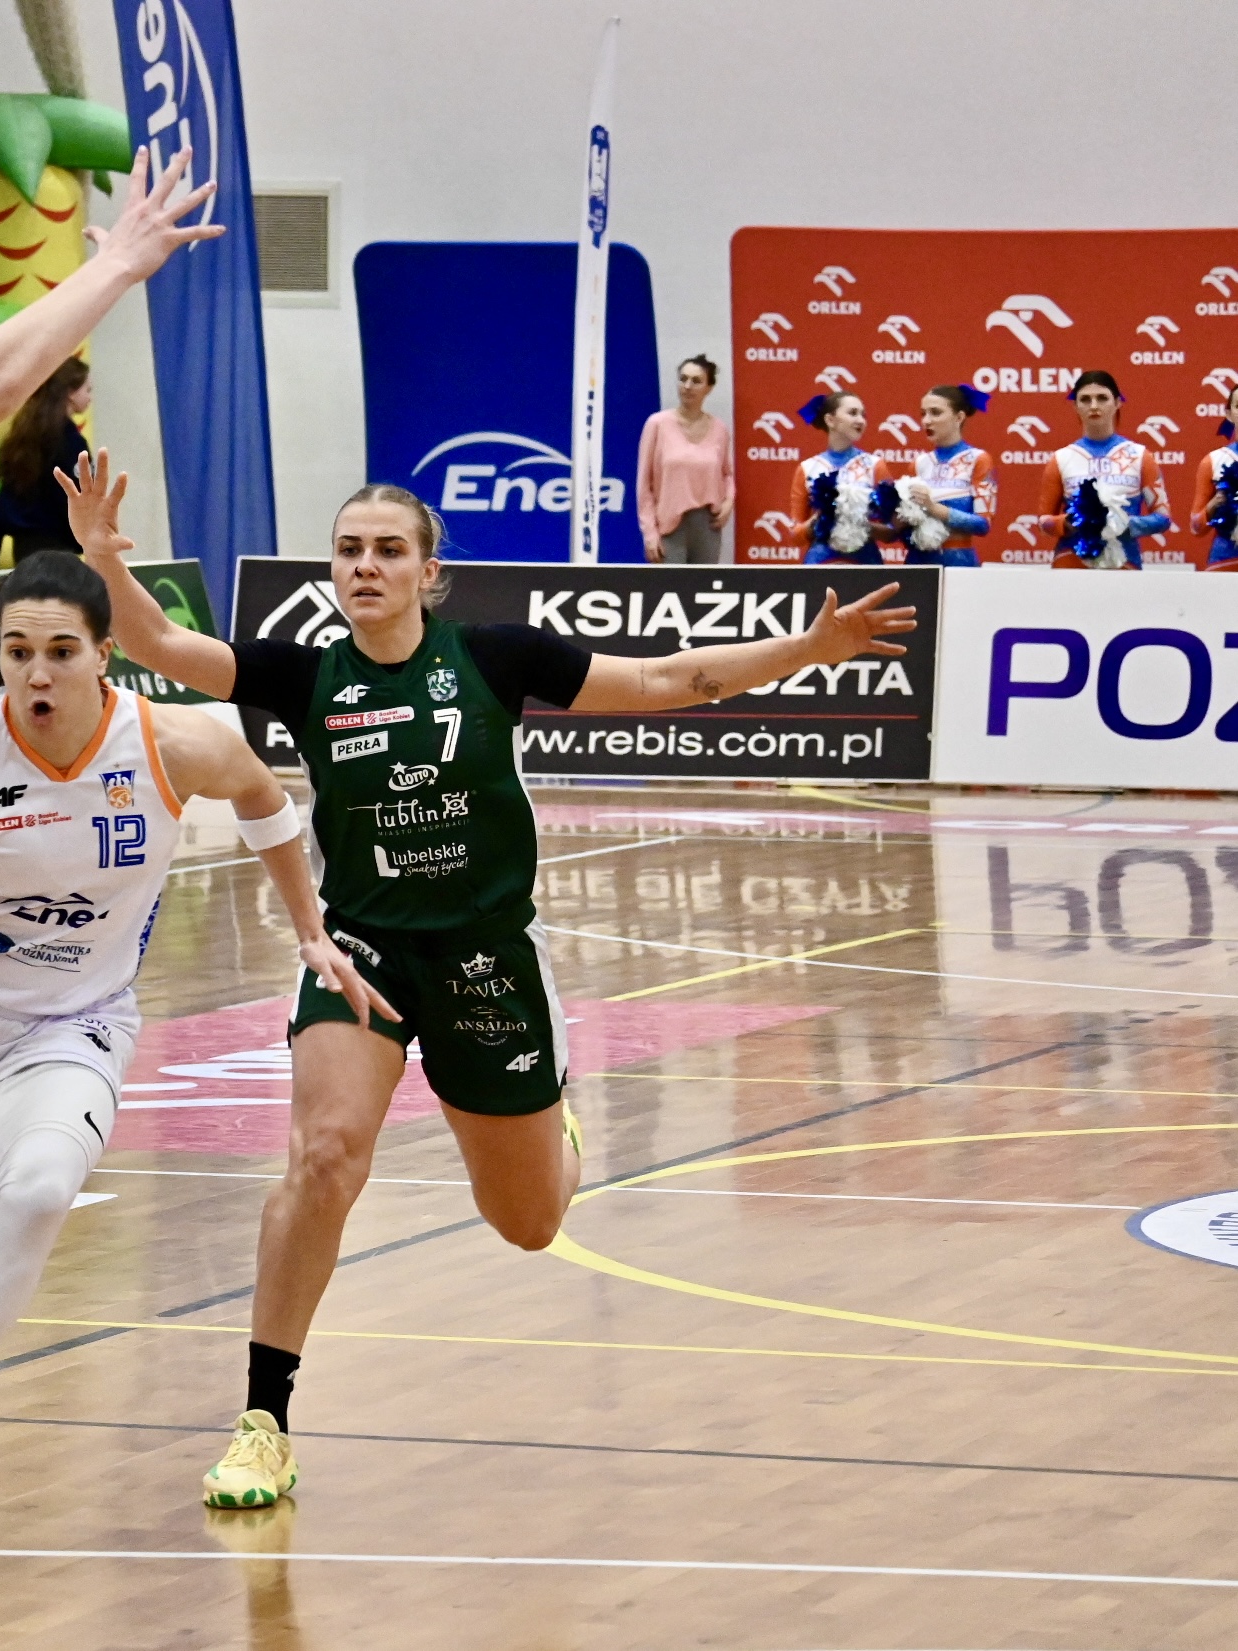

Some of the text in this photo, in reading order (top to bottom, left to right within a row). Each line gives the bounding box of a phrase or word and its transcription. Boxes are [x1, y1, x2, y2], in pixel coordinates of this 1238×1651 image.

[807, 301, 861, 315] ORLEN
[745, 348, 798, 361] ORLEN
[872, 350, 926, 364] ORLEN
[1130, 351, 1185, 365] ORLEN
[972, 366, 1082, 393] ORLEN
[1195, 403, 1226, 417] ORL
[747, 447, 800, 461] ORLEN
[1154, 451, 1185, 465] LEN
[440, 464, 625, 513] Enea
[748, 546, 801, 560] ORLEN
[1142, 550, 1186, 564] RLEN
[528, 580, 806, 650] KSIĄŻKI
[746, 660, 913, 697] ZYTA
[986, 627, 1238, 742] PO
[333, 685, 371, 705] 4F
[328, 716, 361, 727] ORLEN
[433, 707, 461, 762] 7
[522, 725, 883, 764] w.rebis.com.pl
[337, 737, 381, 757] PERŁA
[397, 768, 429, 787] LOTTO
[92, 814, 146, 868] 12
[10, 905, 110, 929] Ene
[446, 976, 517, 998] TAVEX
[453, 1020, 527, 1033] ANSALDO
[505, 1050, 540, 1073] 4F
